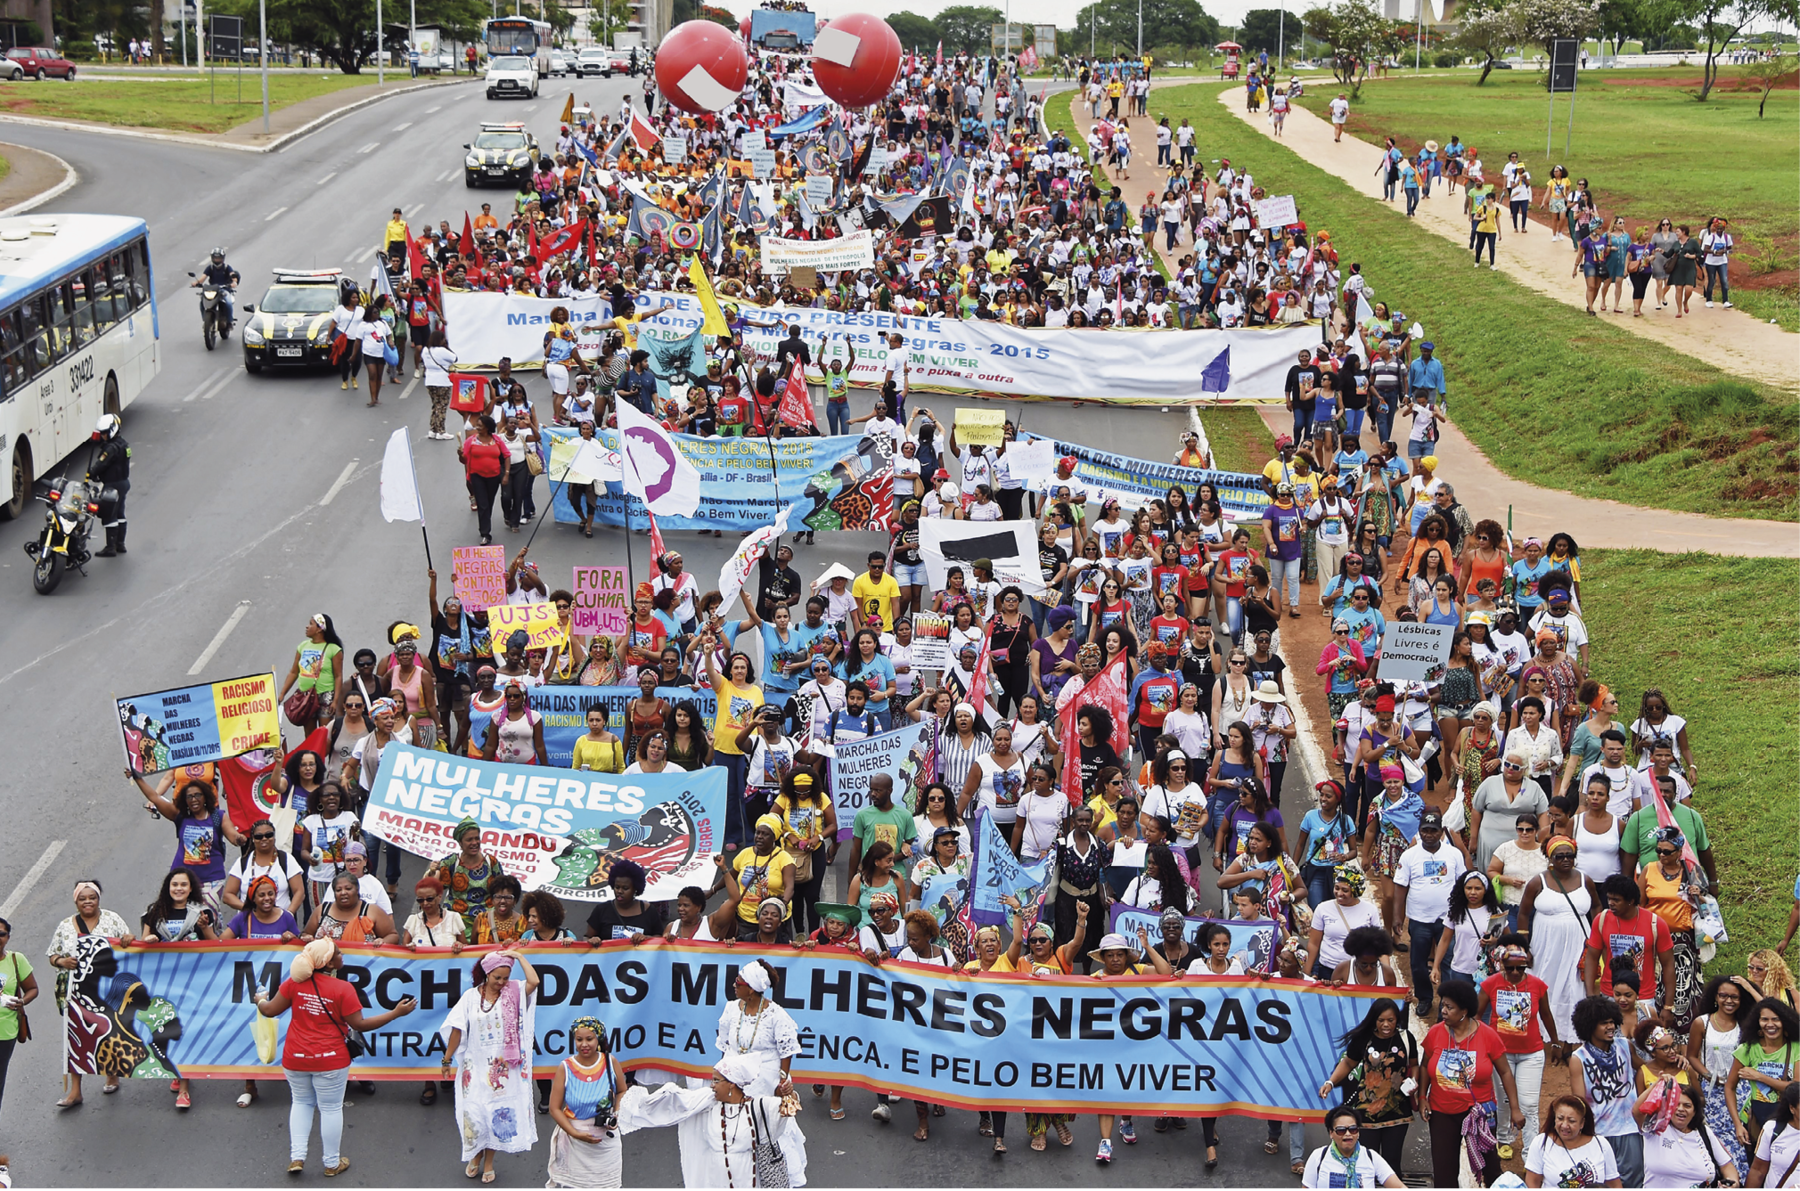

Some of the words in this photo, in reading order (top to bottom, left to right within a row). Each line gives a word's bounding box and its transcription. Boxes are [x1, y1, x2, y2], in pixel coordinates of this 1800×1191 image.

[660, 296, 690, 311] DE
[809, 312, 941, 334] PRESENTE
[507, 310, 598, 325] Marha
[990, 342, 1051, 360] 2015
[646, 328, 658, 338] O
[832, 346, 843, 356] E
[931, 356, 979, 369] VIVER
[69, 354, 94, 394] 331422
[927, 368, 961, 380] puxa
[977, 373, 1014, 384] outra
[721, 441, 778, 455] NEGRAS
[782, 442, 814, 455] 2015
[717, 458, 723, 468] E
[726, 458, 754, 469] PELO
[756, 459, 777, 469] BEM
[781, 459, 814, 469] VIVER!
[1053, 441, 1090, 462] RCHA
[1093, 451, 1123, 469] DAS
[1124, 457, 1203, 484] MULHERES
[1204, 472, 1264, 491] NEGRAS
[700, 472, 718, 483] sília
[726, 473, 739, 483] DF
[746, 472, 772, 483] Brasil
[1080, 462, 1131, 483] RACISMO
[1133, 475, 1139, 484] E
[1141, 476, 1149, 486] A
[1217, 488, 1244, 502] PELO
[1245, 492, 1270, 505] BEM
[1136, 486, 1154, 495] PARA
[594, 503, 615, 513] ntra
[709, 509, 735, 519] Bem
[738, 509, 771, 520] Viver.
[1221, 501, 1244, 512] ALEGRE
[453, 547, 504, 560] MULHERES
[455, 560, 504, 574] NEGRAS
[455, 575, 503, 588] CONTRA
[577, 569, 623, 589] FORA
[465, 604, 481, 612] UJS
[498, 604, 549, 624] UJS
[574, 611, 598, 628] UBM
[603, 612, 627, 633] UJS
[916, 618, 949, 637] UNEGRO
[1398, 624, 1442, 636] Lésbicas
[1394, 638, 1429, 649] Livres
[1432, 640, 1440, 650] é
[1381, 651, 1439, 663] Democracia
[221, 680, 266, 700] RACISMO
[162, 693, 192, 707] MARCHA
[221, 698, 273, 719] RELIGIOSO
[554, 694, 577, 712] DAS
[164, 709, 178, 719] DAS
[545, 714, 582, 727] RACISMO
[166, 717, 201, 732] MULHERES
[246, 718, 252, 730] É
[168, 732, 195, 745] NEGRAS
[231, 732, 271, 751] CRIME
[170, 746, 194, 761] BRASÍLIA
[836, 742, 880, 760] MARCHA
[880, 736, 902, 752] DAS
[837, 753, 892, 775] MULHERES
[391, 751, 646, 815] MULHERES
[384, 778, 574, 834] NEGRAS
[678, 790, 706, 817] 2015
[838, 791, 873, 809] 201
[378, 810, 557, 852] MARCANDO
[697, 817, 713, 861] NEGRAS
[446, 841, 457, 849] O
[538, 884, 608, 899] MARCHA
[231, 960, 462, 1011] MRCH
[536, 960, 649, 1007] DAS
[1030, 996, 1293, 1044] NEGRAS
[360, 1031, 447, 1057] NTRA
[533, 1024, 646, 1055] ACIMO
[658, 1022, 676, 1048] E
[684, 1029, 706, 1054] A
[901, 1048, 920, 1074] E
[930, 1053, 1019, 1087] PELO
[1030, 1062, 1104, 1089] BEM
[1115, 1063, 1217, 1092] VIVER
